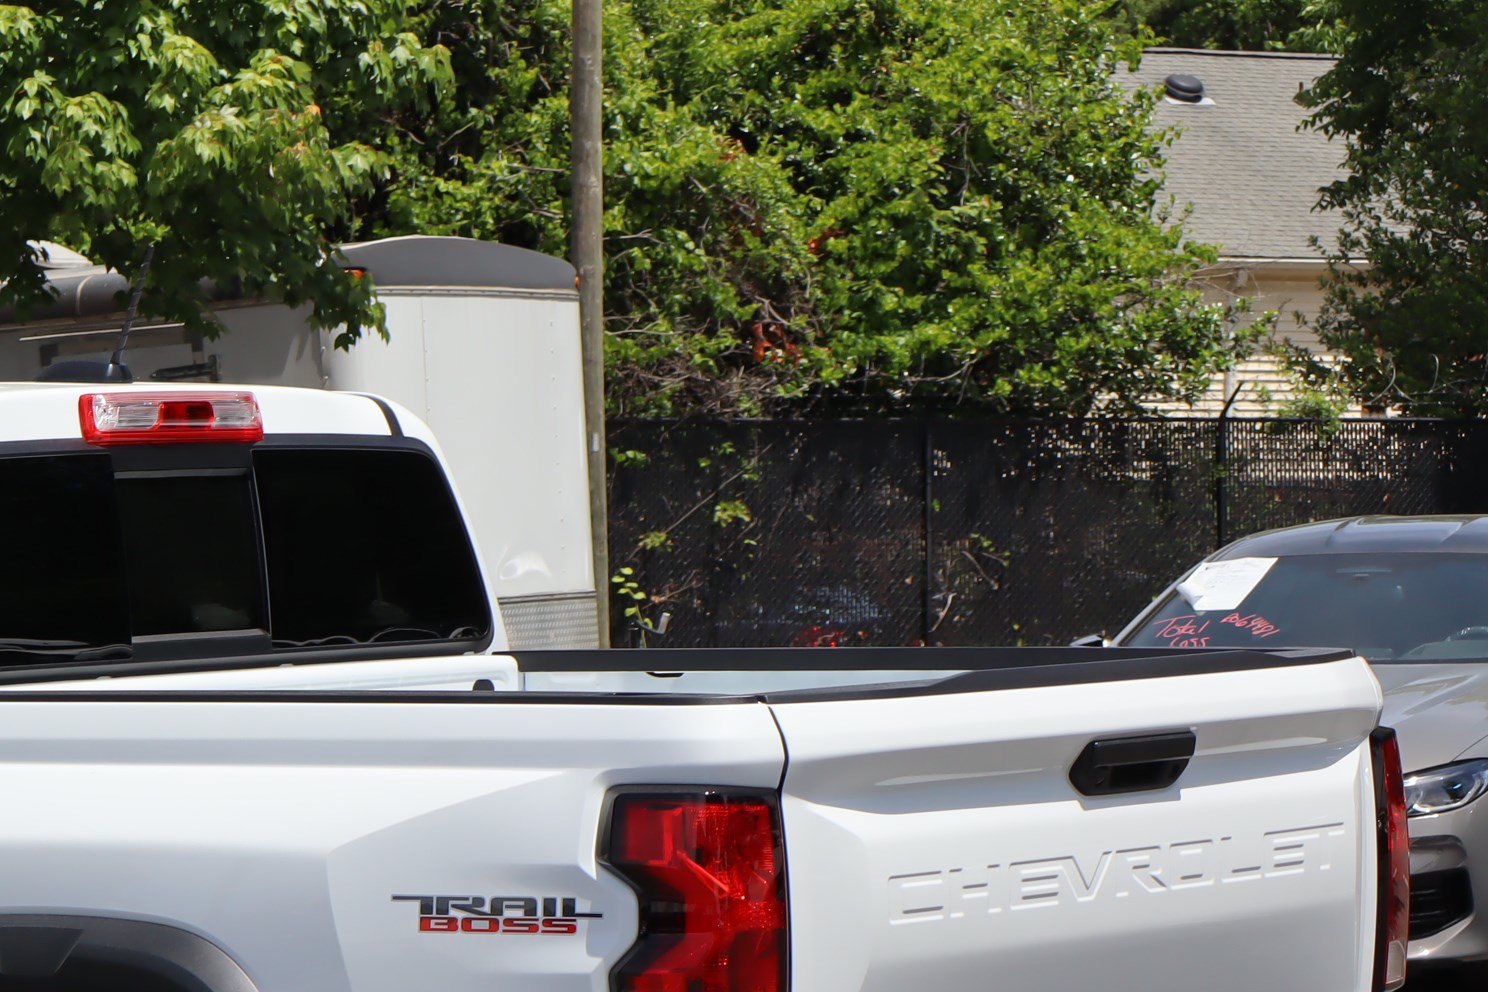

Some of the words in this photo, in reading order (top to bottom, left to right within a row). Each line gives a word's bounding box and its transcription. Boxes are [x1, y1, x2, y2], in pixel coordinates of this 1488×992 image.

[1152, 615, 1210, 638] Total
[888, 822, 1345, 925] CHEVROLET
[392, 895, 603, 918] TRAIL
[419, 916, 577, 934] BOSS
